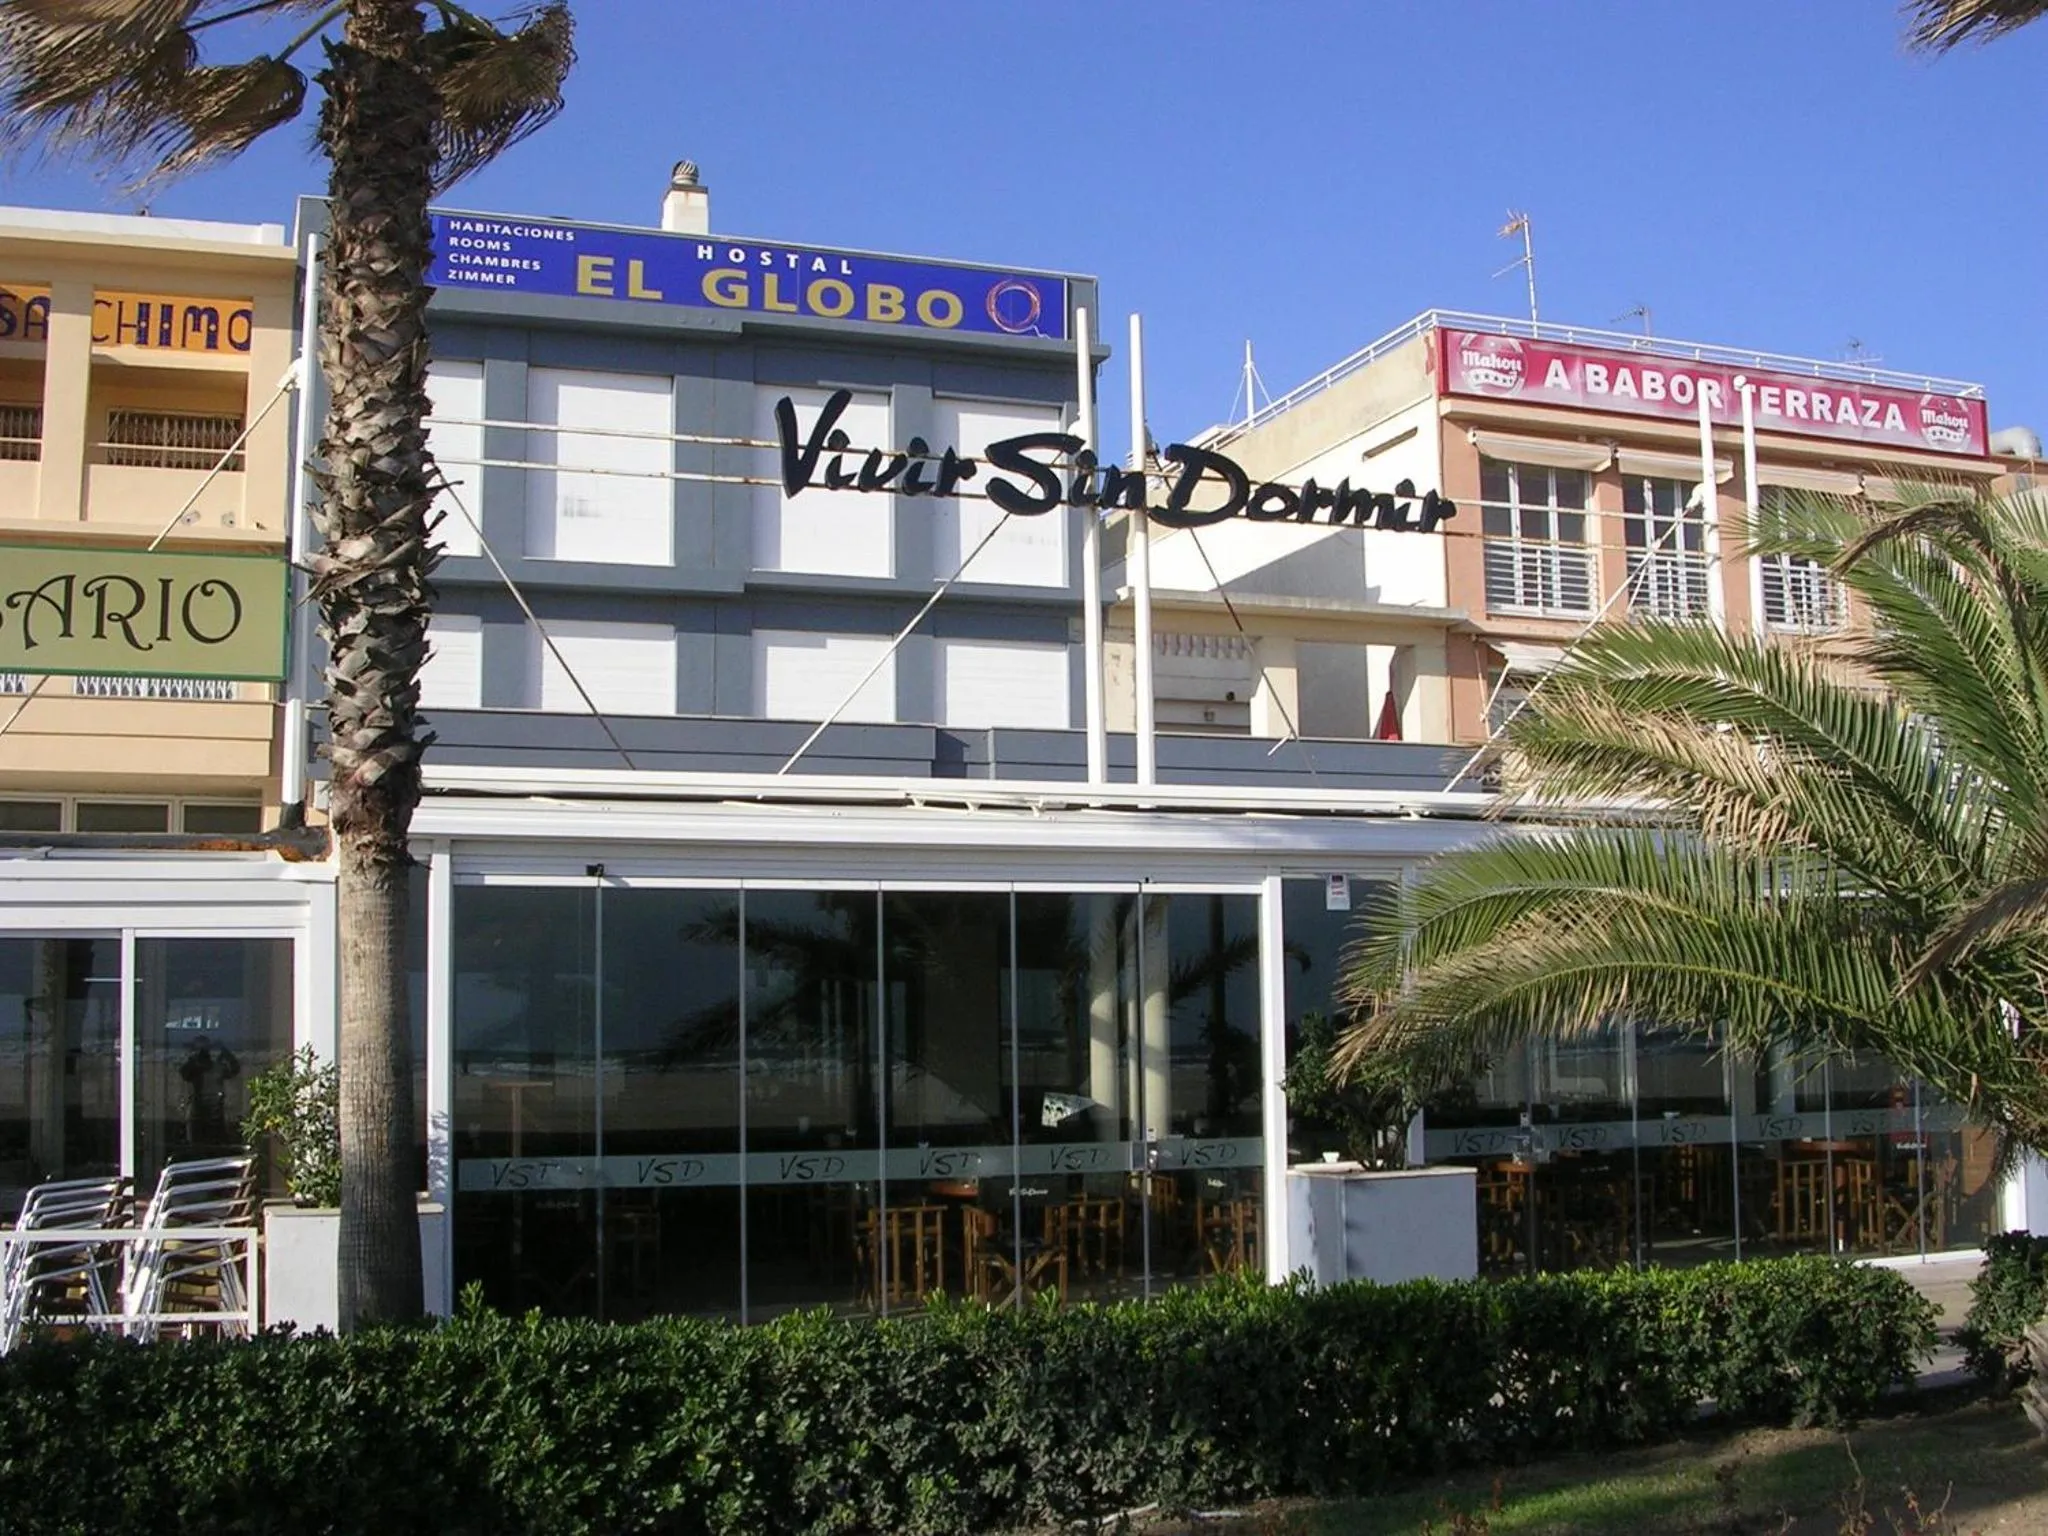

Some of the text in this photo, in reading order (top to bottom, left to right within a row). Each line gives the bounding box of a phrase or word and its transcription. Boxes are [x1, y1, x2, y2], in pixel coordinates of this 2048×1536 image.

[450, 220, 575, 242] HABITACIONES
[450, 237, 511, 251] ROOMS
[449, 252, 541, 271] CHAMBRES
[697, 244, 853, 275] HOSTAL
[448, 269, 516, 285] ZIMMER
[577, 254, 964, 329] EL GLOBO
[92, 299, 253, 352] CHIMO
[1544, 359, 1571, 391] A
[1584, 363, 1723, 408] BABOR
[775, 388, 1457, 533] Vivir Sin Dormir
[0, 574, 242, 651] ARIO
[780, 1154, 845, 1180] VSD
[1181, 1143, 1237, 1166] VSD
[638, 1158, 705, 1184] VSD
